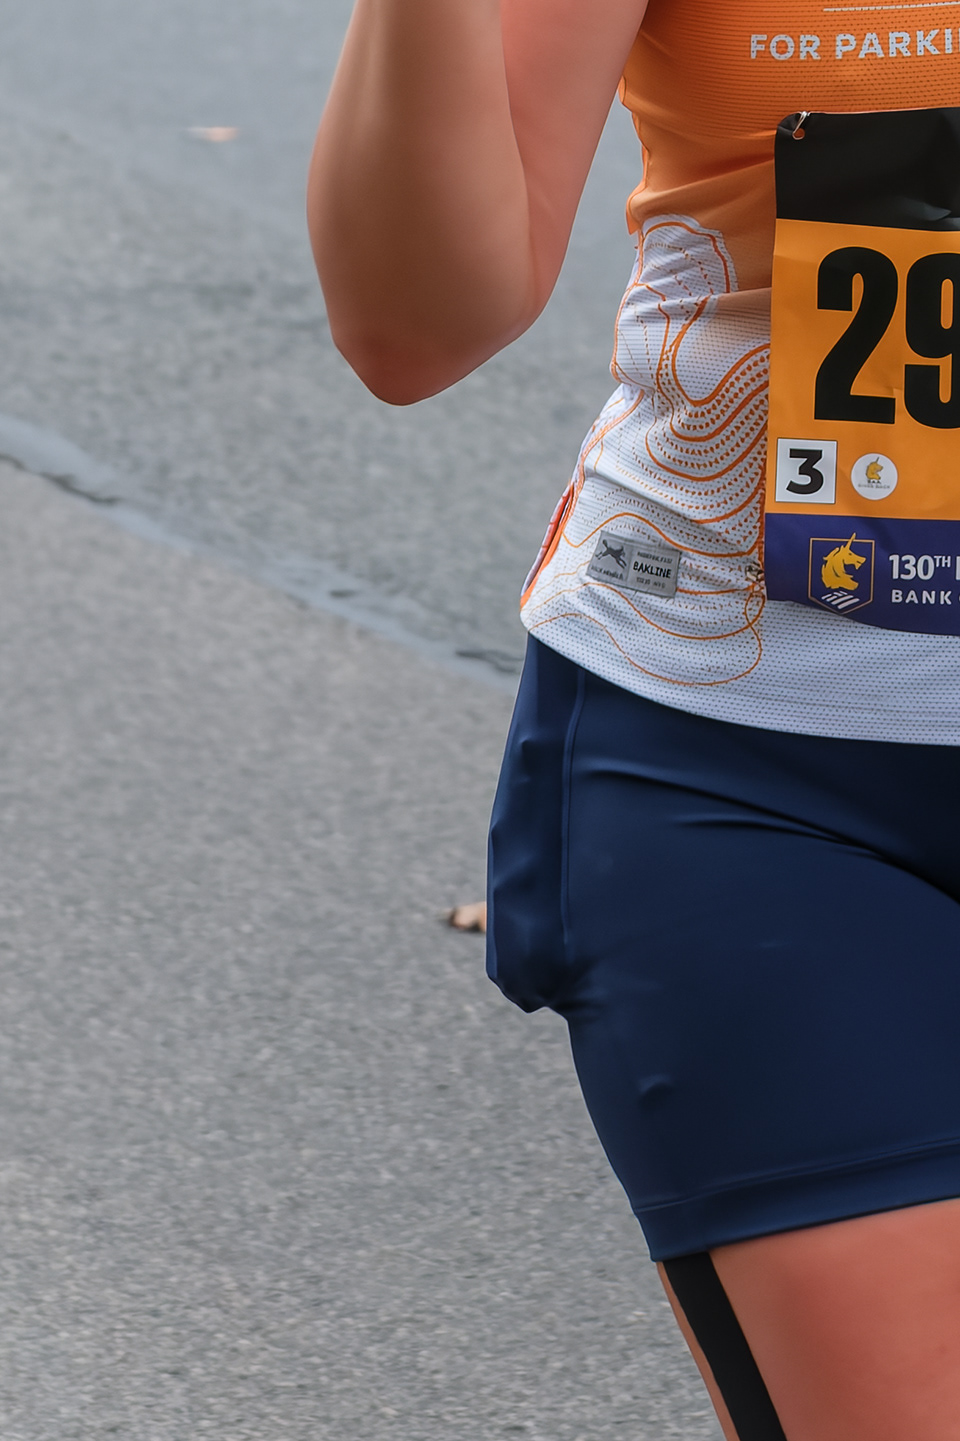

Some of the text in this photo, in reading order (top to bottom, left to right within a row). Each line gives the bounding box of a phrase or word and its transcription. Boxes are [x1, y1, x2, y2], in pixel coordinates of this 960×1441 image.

[749, 32, 822, 61] FOR
[786, 448, 824, 495] 3
[633, 561, 672, 579] BAKLINE
[888, 554, 951, 580] 130TH
[891, 589, 953, 605] BANK
